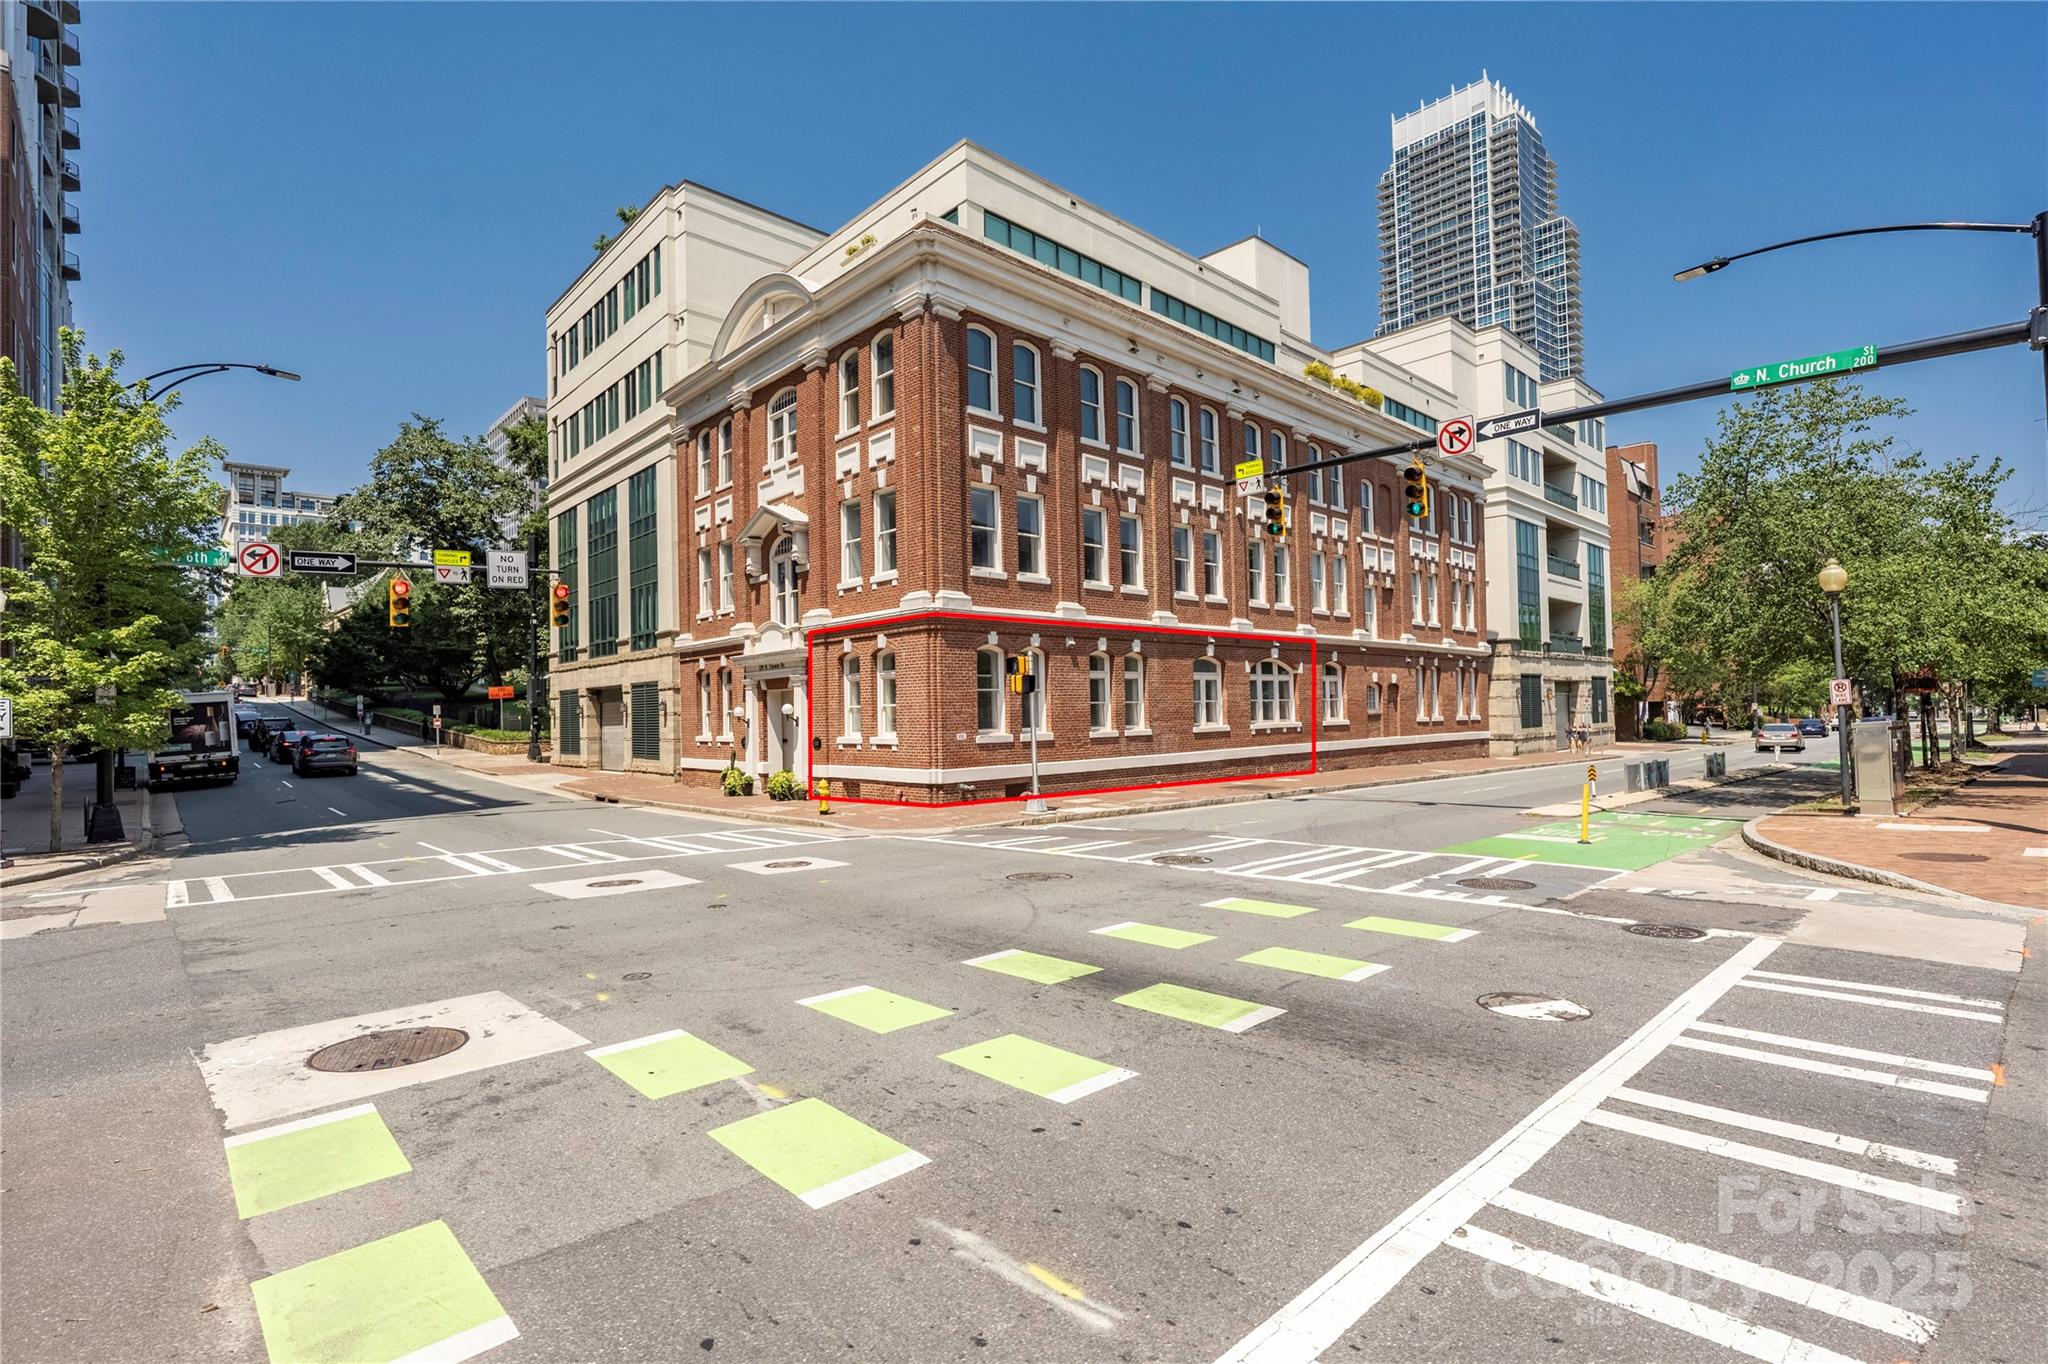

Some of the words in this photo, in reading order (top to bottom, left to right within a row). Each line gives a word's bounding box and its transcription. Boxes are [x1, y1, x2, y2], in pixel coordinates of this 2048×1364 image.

[1863, 344, 1874, 356] St
[1854, 355, 1874, 368] 200
[1756, 368, 1770, 383] N.
[1778, 355, 1836, 378] Church
[1494, 422, 1512, 432] ONE
[1514, 417, 1533, 428] WAY
[297, 558, 315, 566] ONE
[500, 555, 514, 563] NO
[497, 565, 519, 573] TURN
[492, 575, 504, 583] ON
[507, 576, 524, 584] RED
